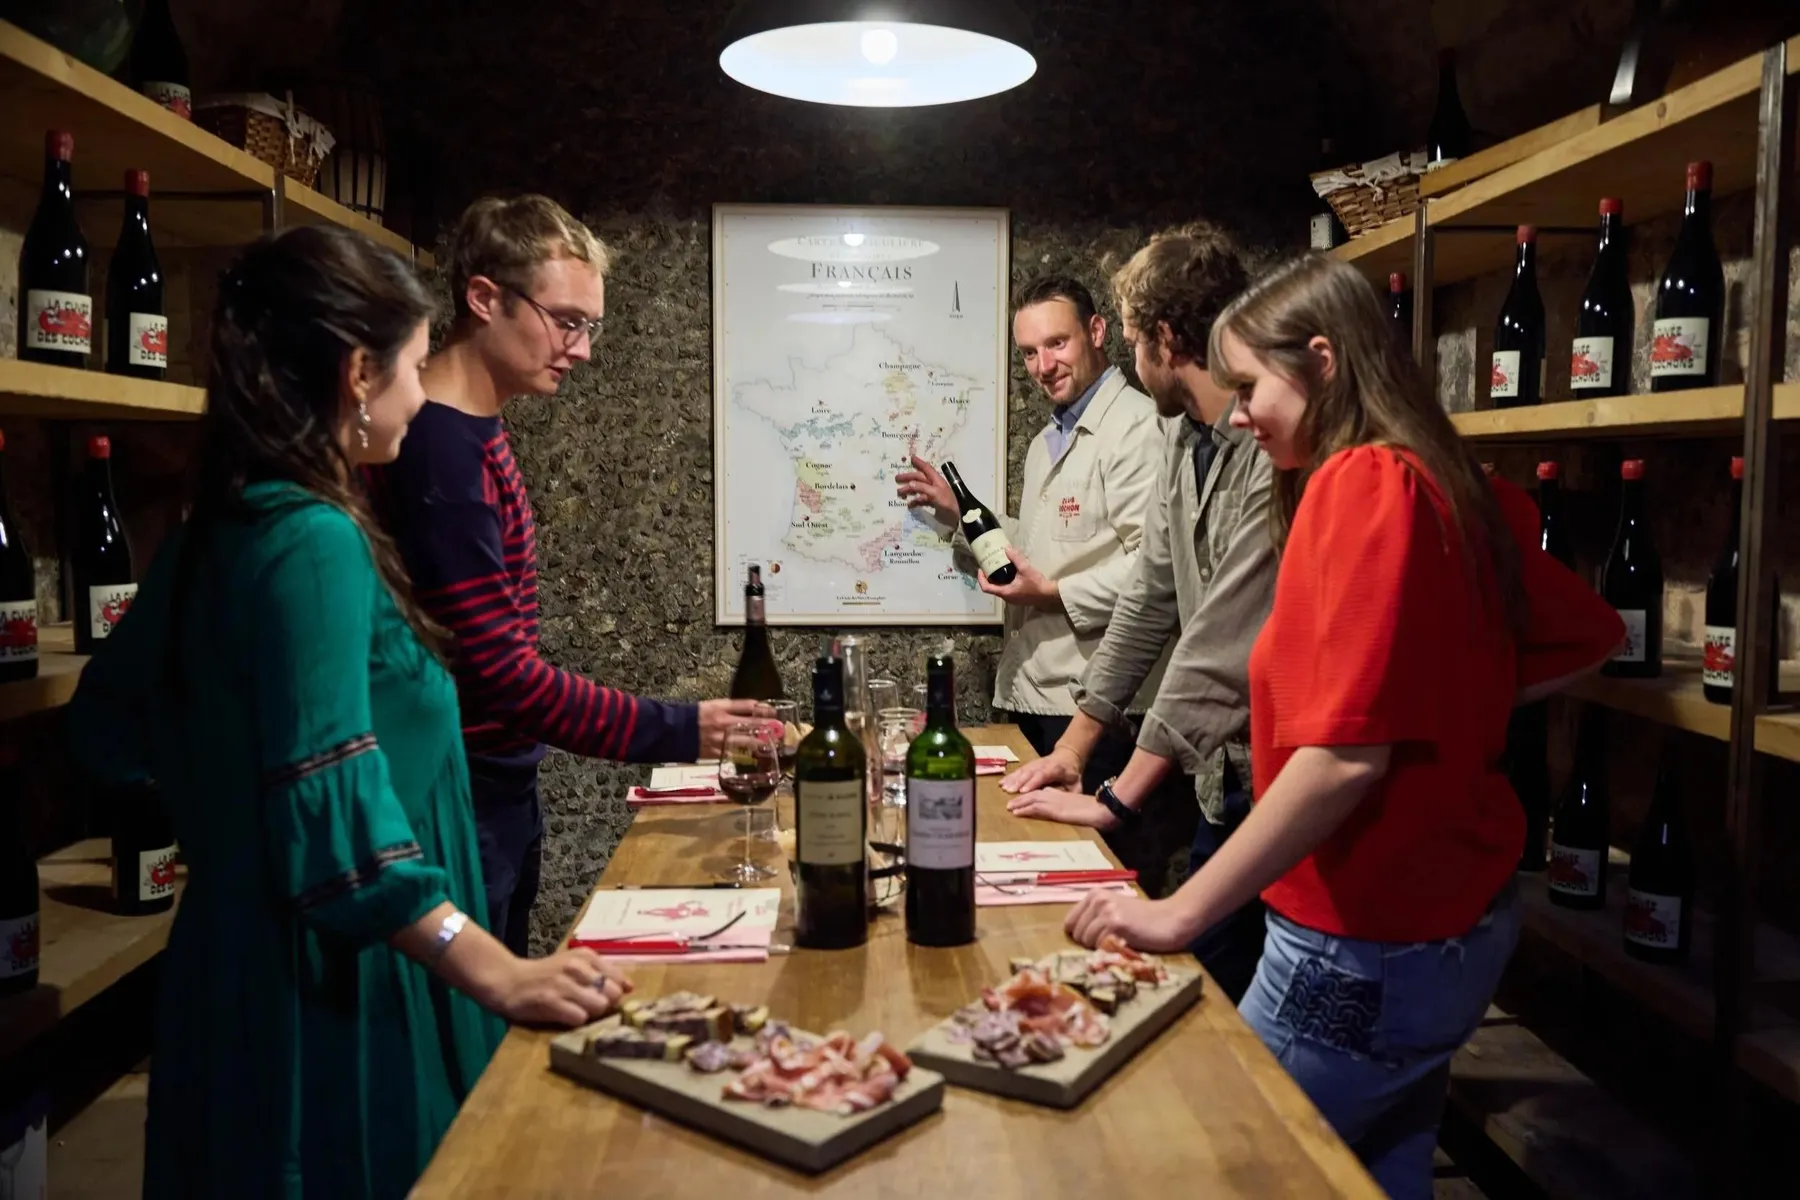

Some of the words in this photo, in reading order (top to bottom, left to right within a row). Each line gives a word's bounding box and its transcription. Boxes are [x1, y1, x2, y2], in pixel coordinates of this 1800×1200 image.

[811, 261, 913, 283] FRANÇAIS
[878, 361, 921, 372] Champagne
[947, 396, 970, 404] Alsace
[811, 406, 831, 414] Loire
[805, 461, 833, 471] Cognac
[814, 482, 849, 491] Bordelais
[884, 549, 925, 559] Languedoc
[937, 573, 959, 581] Corse
